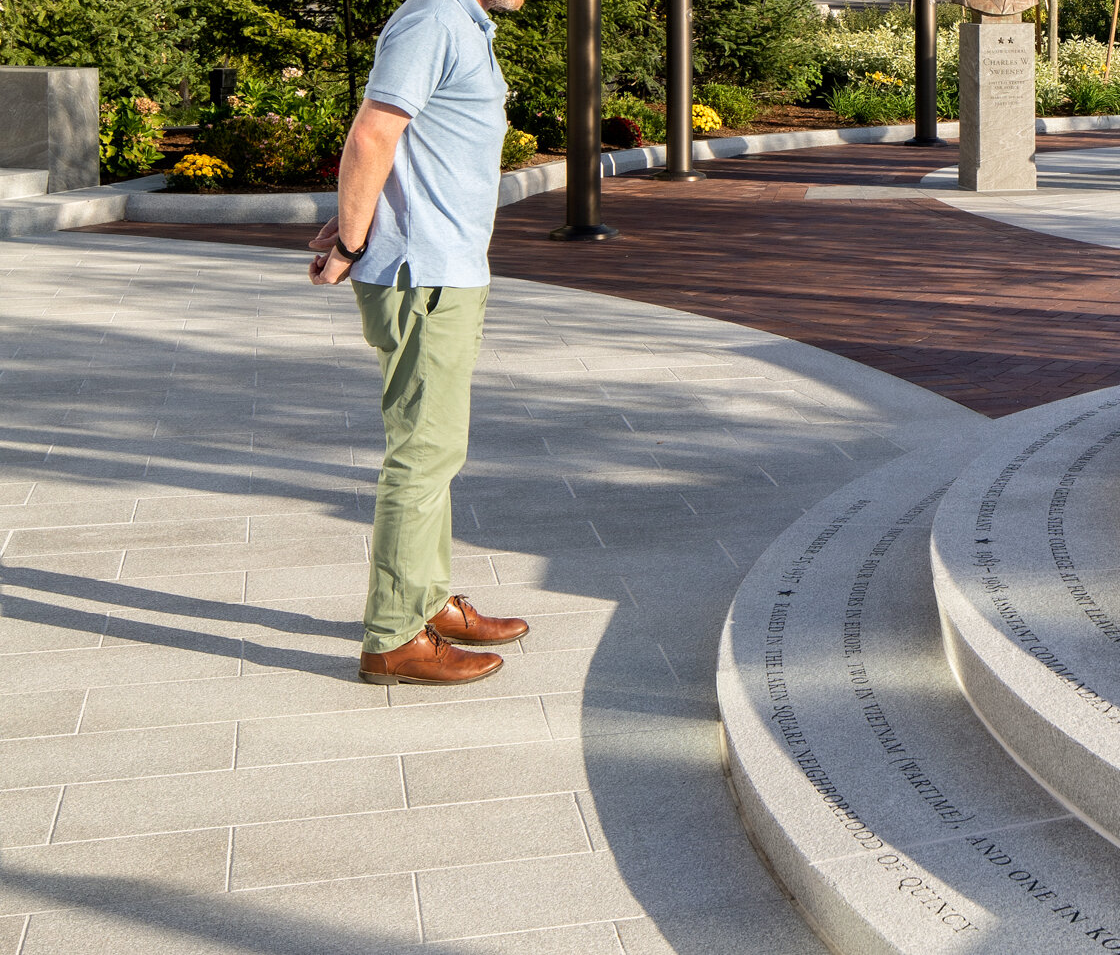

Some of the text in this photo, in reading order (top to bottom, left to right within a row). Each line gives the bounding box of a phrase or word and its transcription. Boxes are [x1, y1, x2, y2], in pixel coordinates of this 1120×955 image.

[983, 57, 1018, 65] CHARLES
[990, 67, 1024, 75] SWEENEY
[1059, 473, 1077, 487] AND
[1049, 487, 1070, 516] GENERAL
[803, 517, 850, 555] SEPTEMBER
[1048, 517, 1064, 536] STAFF
[869, 528, 904, 557] INCLUDE
[1049, 538, 1074, 570] COLLEGE
[856, 559, 880, 579] FOUR
[976, 499, 998, 532] GERMANY
[992, 596, 1041, 643] ASSISTANT
[1060, 572, 1080, 582] AT
[847, 582, 869, 607] TOURS
[1067, 585, 1097, 606] FORT
[767, 602, 790, 633] RAISED
[846, 609, 862, 619] IN
[766, 635, 783, 646] IN
[842, 622, 861, 659] EUROPE,
[765, 650, 783, 668] THE
[847, 661, 869, 685] TWO
[854, 688, 875, 700] IN
[771, 705, 807, 747] SQUARE
[863, 703, 905, 755] VIETNAM
[793, 749, 884, 850] NEIGHBORHOOD
[888, 757, 976, 830] (WARTIME),
[877, 854, 909, 871] OF
[966, 837, 1012, 866] AND
[1008, 870, 1057, 902] ONE
[898, 876, 980, 933] QUINCY
[1051, 904, 1088, 924] IN
